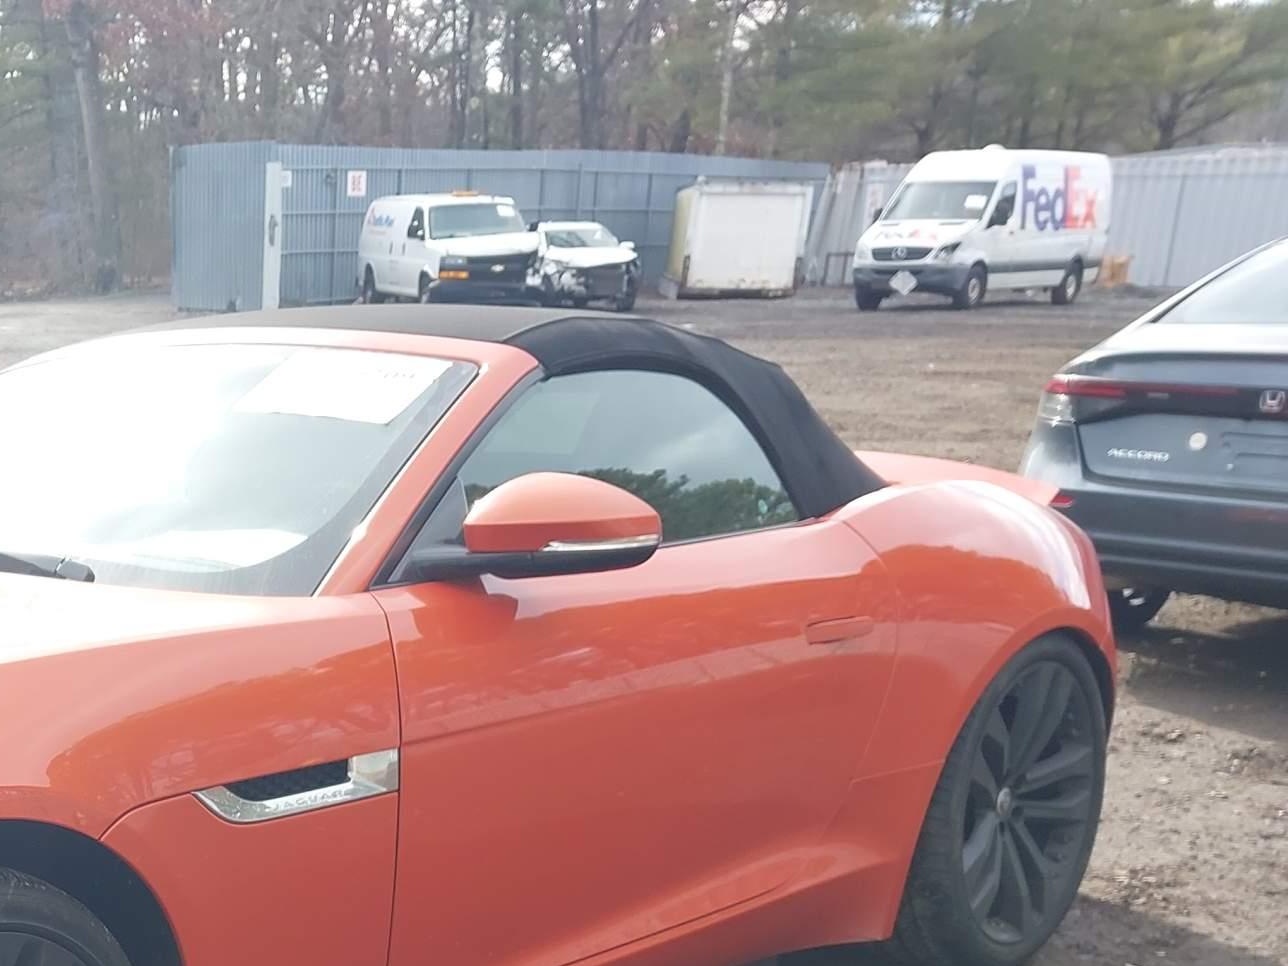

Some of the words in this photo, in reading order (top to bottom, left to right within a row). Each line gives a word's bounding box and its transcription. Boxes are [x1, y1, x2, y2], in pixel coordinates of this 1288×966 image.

[1020, 164, 1097, 231] FedEx
[1107, 447, 1170, 462] ACCORD
[272, 790, 344, 811] JAGUAR
